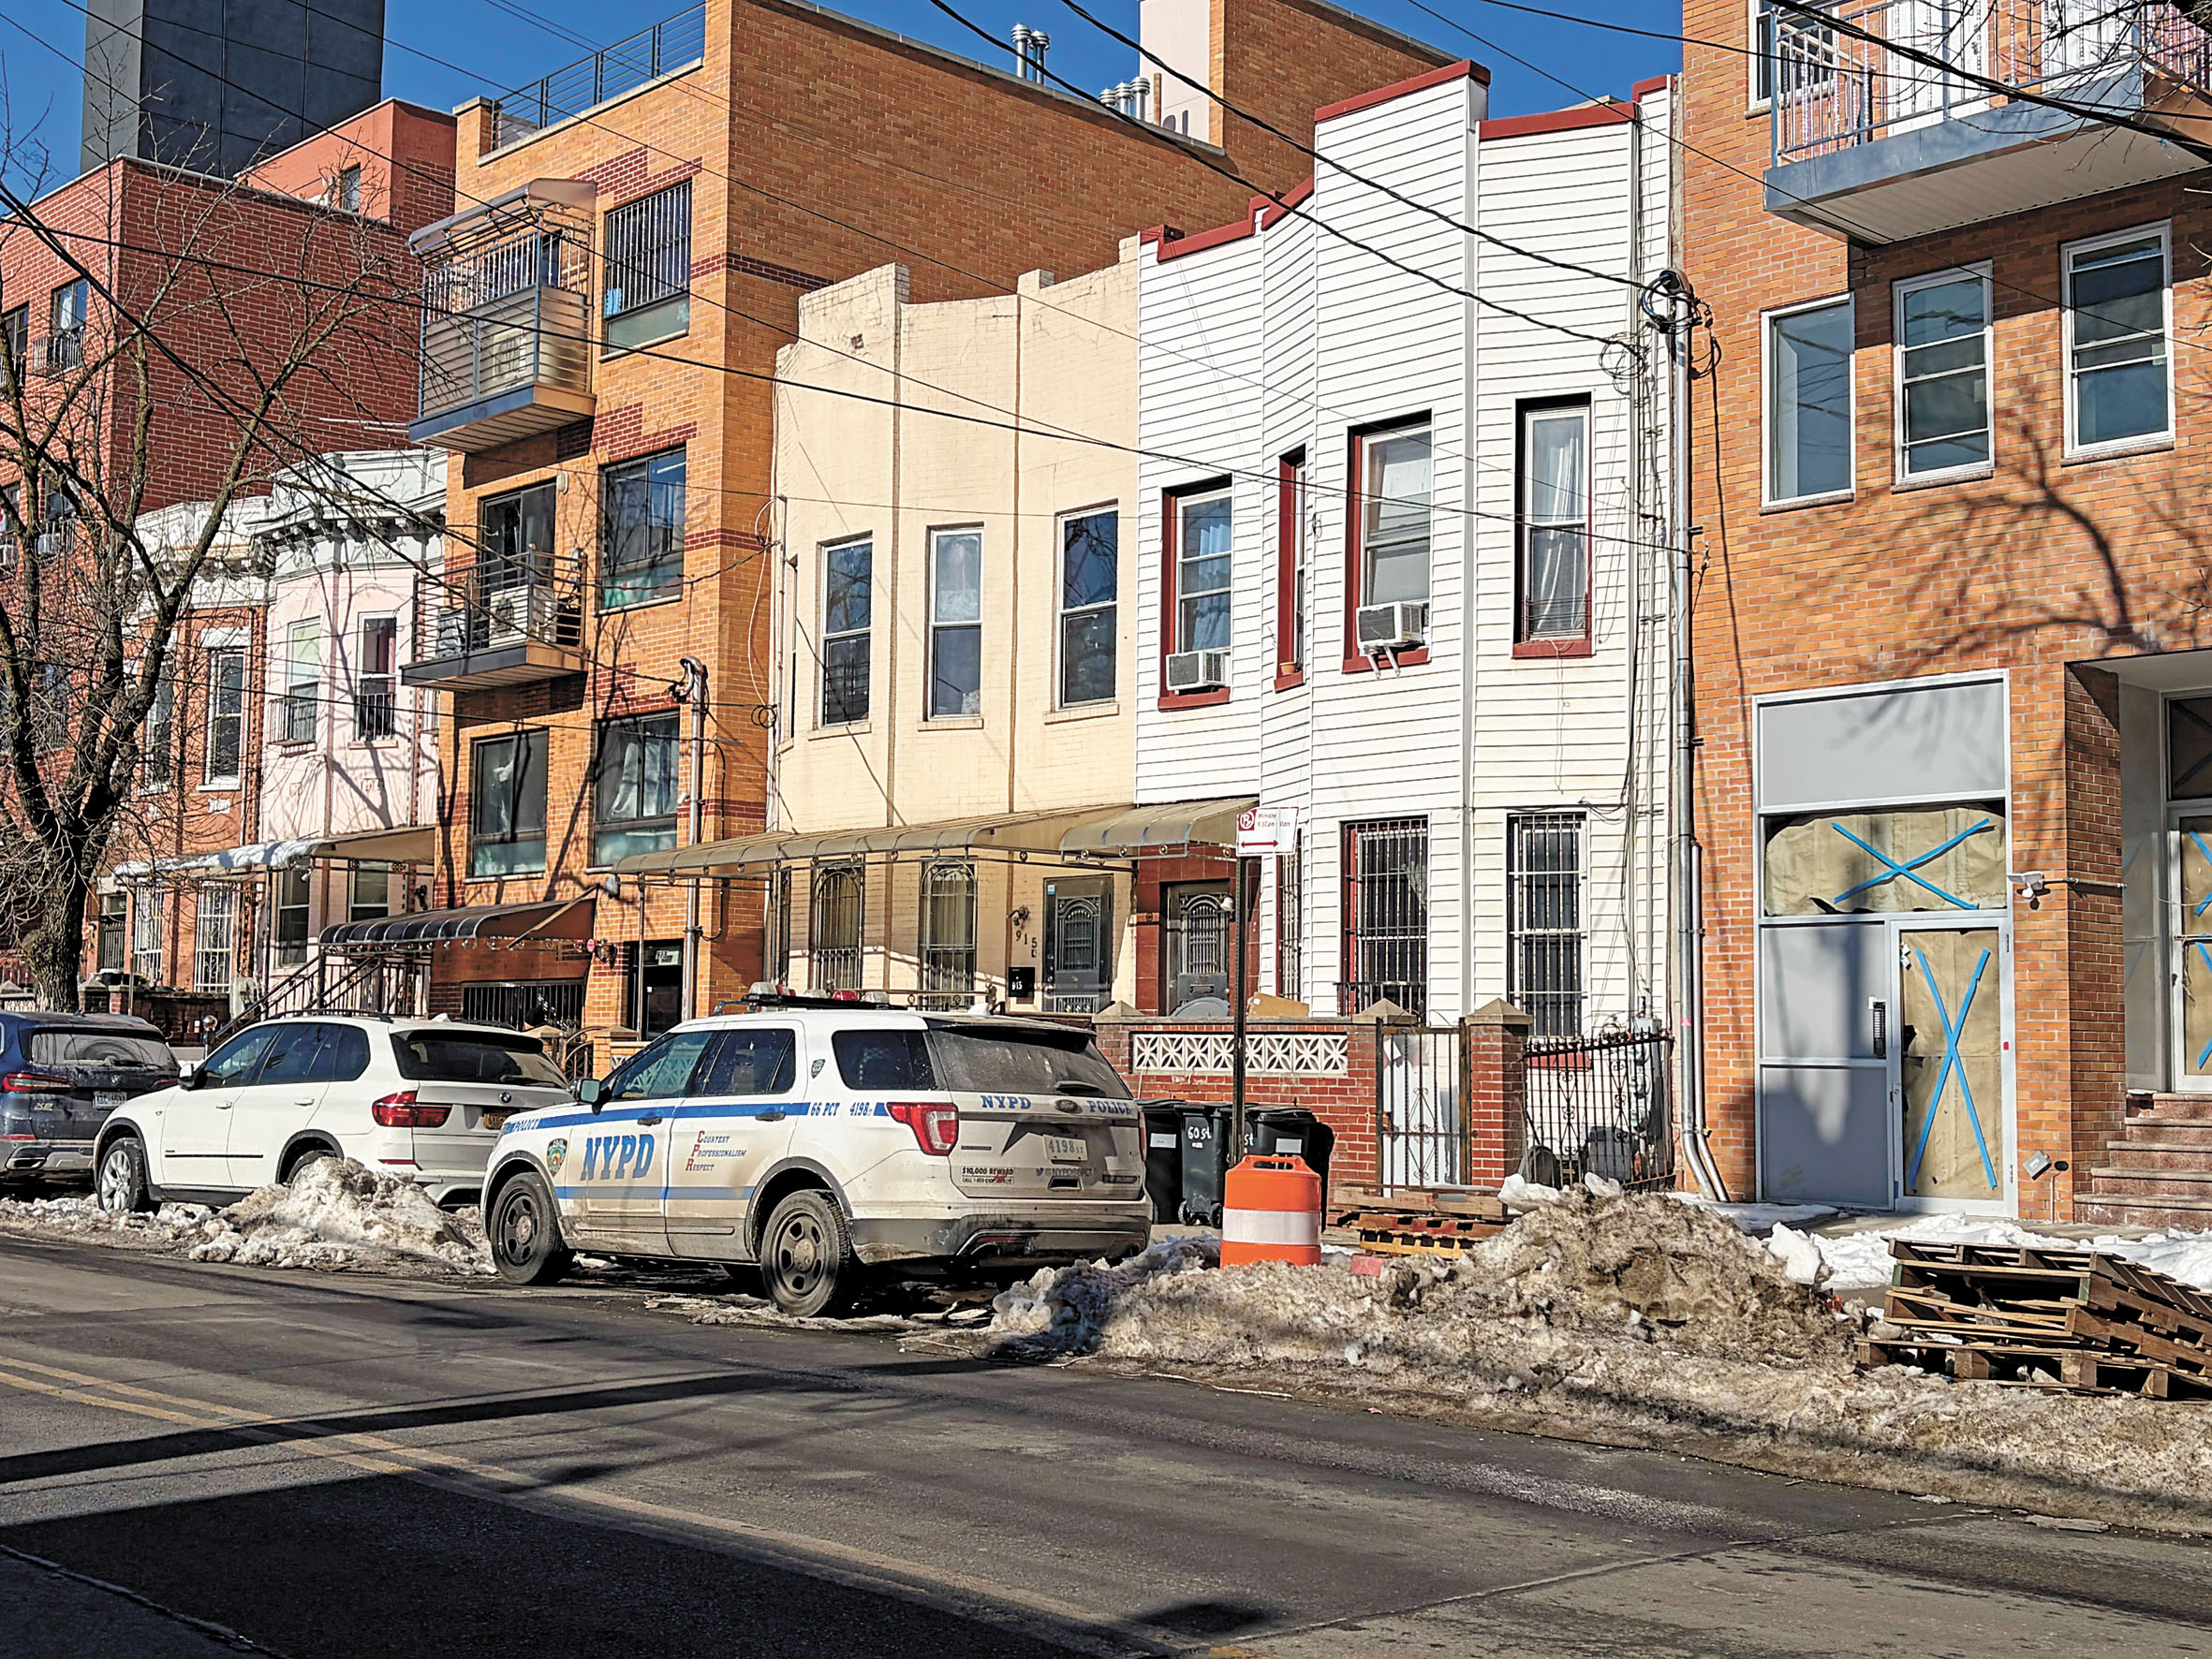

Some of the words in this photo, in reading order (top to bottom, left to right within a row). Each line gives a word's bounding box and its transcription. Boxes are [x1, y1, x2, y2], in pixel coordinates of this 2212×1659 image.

[1015, 930, 1038, 948] 915
[810, 1102, 822, 1117] 66
[822, 1102, 841, 1117] PCT
[849, 1102, 870, 1117] 4198
[981, 1094, 1032, 1109] NYPD
[1086, 1100, 1132, 1115] POLICE
[691, 1144, 747, 1157] PROFESSIONALISM
[1048, 1139, 1075, 1153] 4198
[580, 1134, 656, 1182] NYPD
[685, 1158, 715, 1171] RESPECT
